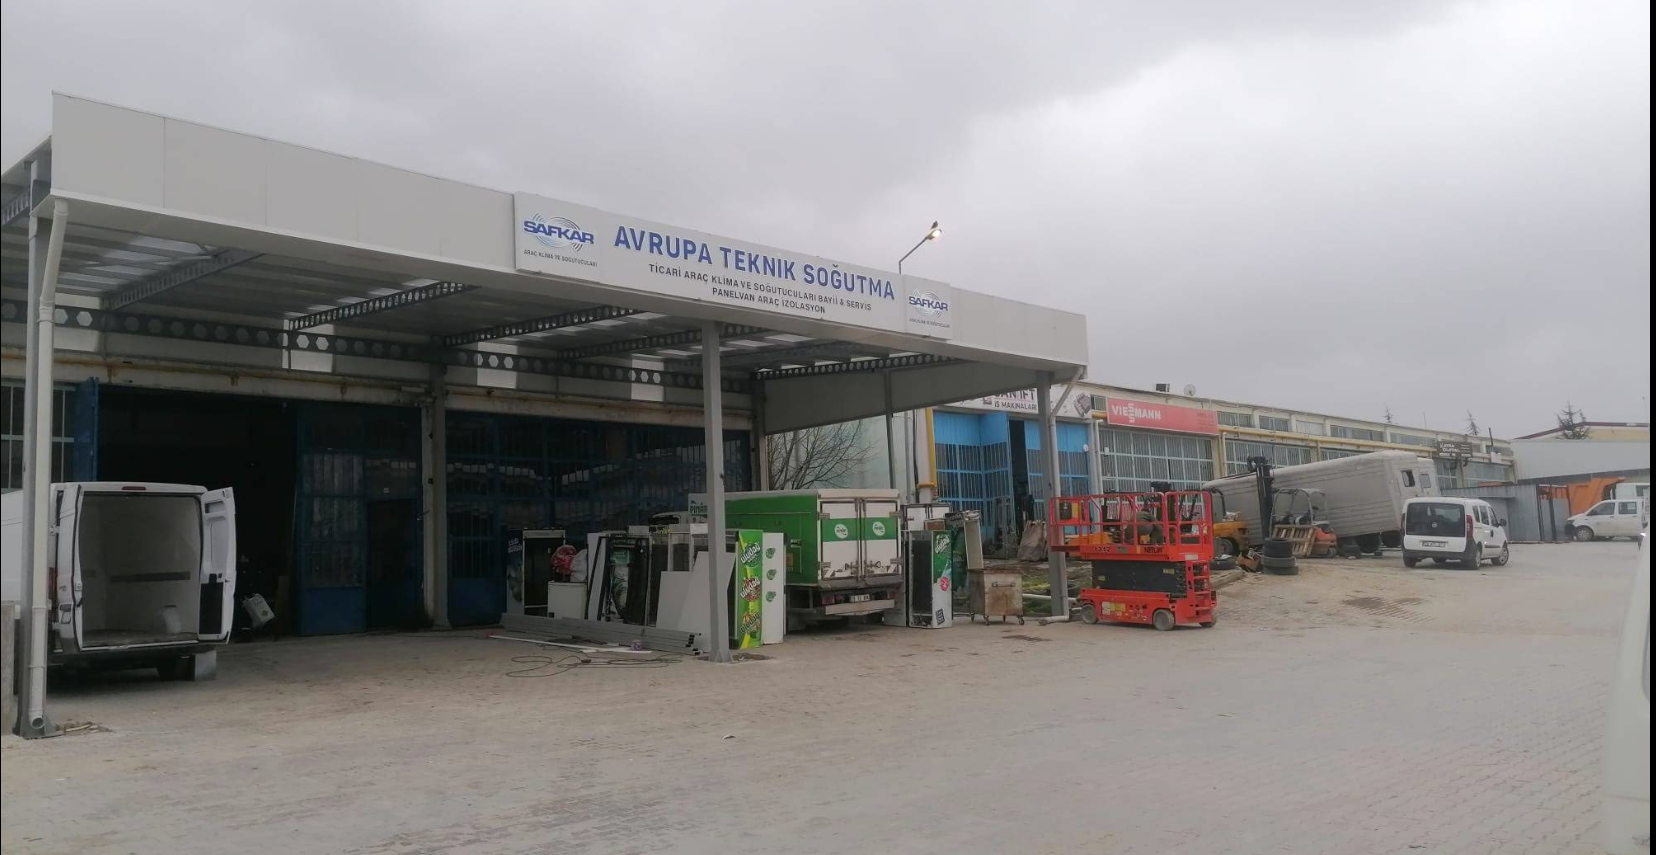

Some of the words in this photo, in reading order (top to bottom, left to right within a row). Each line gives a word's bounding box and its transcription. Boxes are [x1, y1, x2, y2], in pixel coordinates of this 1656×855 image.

[523, 220, 595, 244] SAFKAR
[614, 225, 712, 265] AVRUPA
[803, 263, 895, 300] SOĞUTMA
[648, 261, 681, 278] TİCARİ
[684, 270, 709, 284] ARAÇ
[711, 273, 739, 288] KLİMA
[740, 280, 752, 290] VE
[753, 282, 817, 301] SOĞUTUCULARI
[839, 298, 845, 306] &
[712, 287, 755, 302] PANELVAN
[757, 294, 780, 307] ARAÇ
[781, 296, 826, 314] İZOLASYON
[908, 295, 949, 311] SAFKAR
[1111, 403, 1161, 423] VIESSMANN
